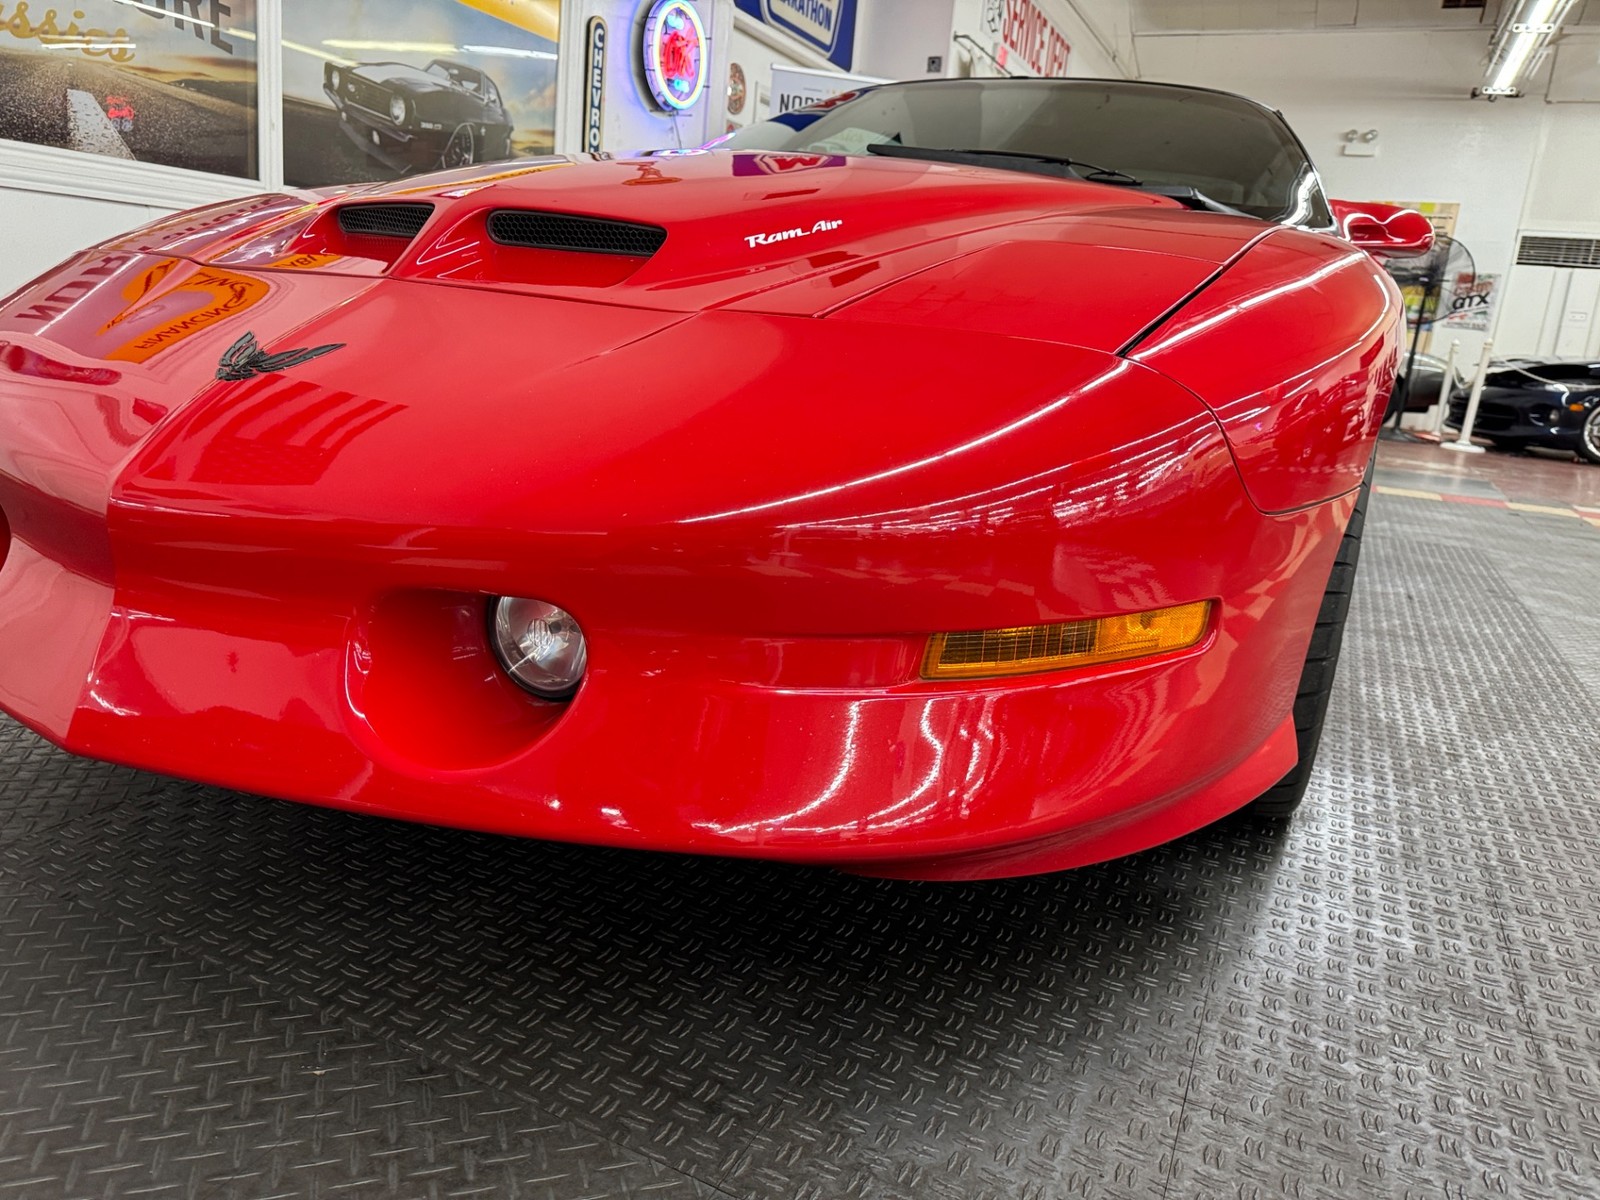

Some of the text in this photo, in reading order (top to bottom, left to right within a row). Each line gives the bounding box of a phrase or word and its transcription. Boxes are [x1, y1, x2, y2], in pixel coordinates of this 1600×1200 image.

[0, 1, 136, 62] ssics
[744, 219, 843, 248] Ram Air
[1452, 292, 1491, 310] GTX
